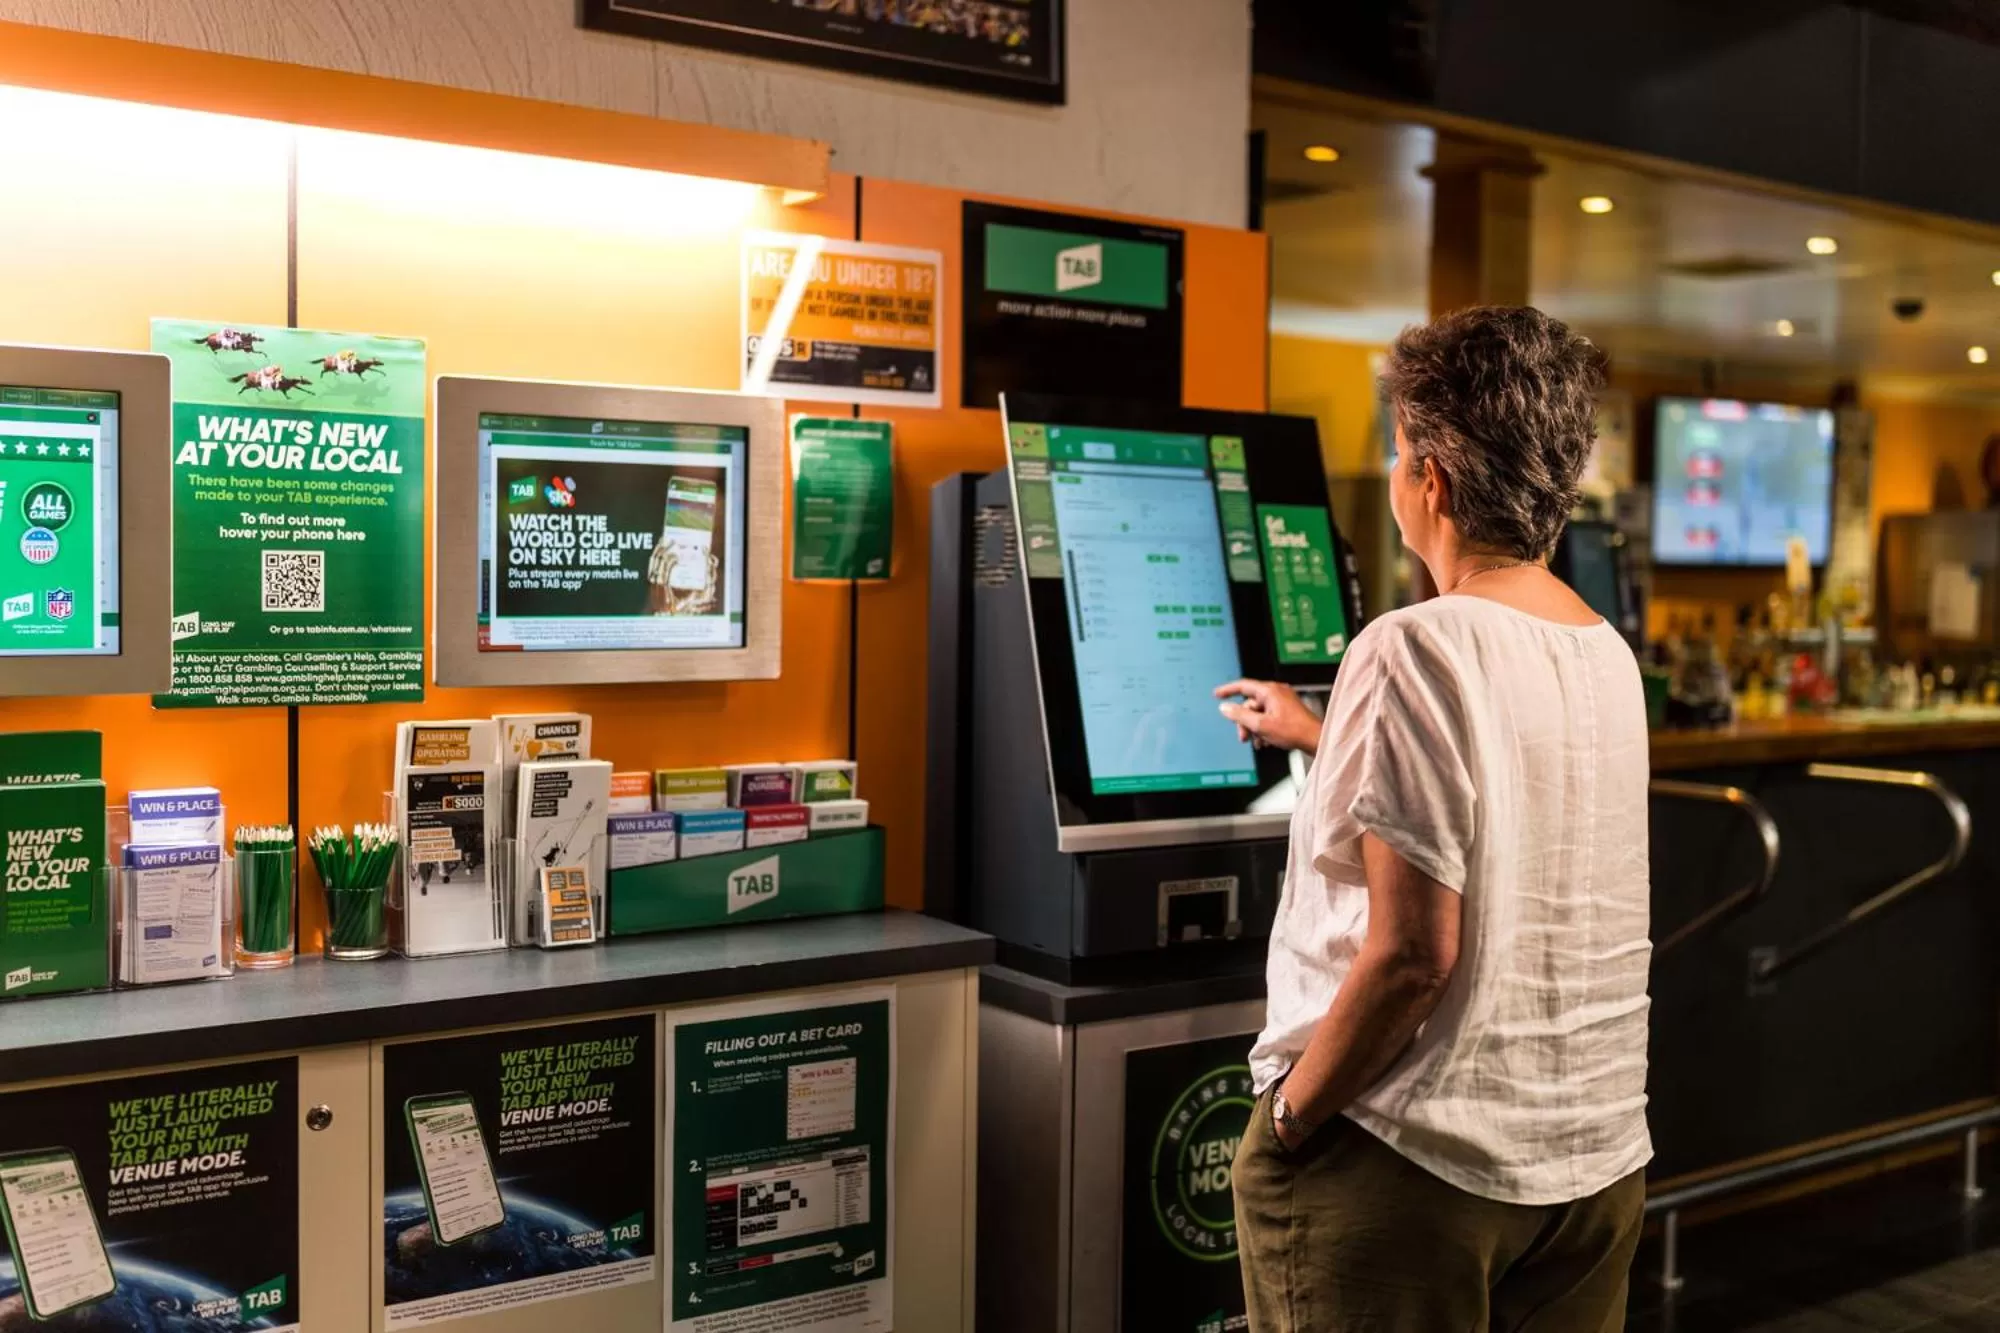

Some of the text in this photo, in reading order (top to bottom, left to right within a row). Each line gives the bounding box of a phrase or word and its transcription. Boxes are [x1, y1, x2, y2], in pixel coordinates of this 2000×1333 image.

[752, 253, 790, 278] ARE
[1063, 257, 1097, 277] TAB
[836, 260, 897, 289] UNDER
[904, 267, 933, 292] 18?
[997, 300, 1147, 328] more action more places
[198, 416, 389, 448] WHAT'S NEW
[175, 441, 403, 474] AT YOUR LOCAL
[188, 474, 394, 493] There have been some changes
[511, 485, 534, 497] TAB
[30, 494, 66, 511] ALL
[195, 490, 388, 507] made to your TAB experience.
[548, 491, 573, 503] SKY
[29, 509, 68, 521] GAMES
[240, 512, 346, 526] To find out more
[508, 513, 607, 532] WATCH THE
[219, 526, 366, 542] hover your phone here
[508, 531, 653, 550] WORLD CUP LIVE
[509, 549, 621, 566] ON SKY HERE
[508, 568, 639, 582] Plus stream every match live
[508, 580, 521, 589] on
[523, 579, 539, 589] the
[541, 579, 560, 589] TAB
[6, 601, 30, 613] TAB
[50, 602, 72, 615] NFL
[173, 622, 196, 633] TAB
[269, 624, 413, 636] Or go to tabinfo.com.au/whatsnew
[186, 653, 217, 663] About
[219, 655, 241, 665] your
[242, 653, 282, 663] choices.
[283, 652, 302, 662] Call
[304, 652, 352, 661] Gambler's
[354, 652, 376, 662] Help,
[378, 652, 423, 662] Gambling
[181, 661, 422, 674] or the ACT Gambling Counselling & Support Service
[189, 674, 212, 684] 1800
[214, 674, 233, 683] 858
[235, 674, 253, 683] 858
[254, 673, 395, 685] www.gamblinghelp.nsw.gov.au
[396, 672, 406, 681] or
[315, 682, 341, 692] Don't
[342, 682, 369, 691] chase
[370, 682, 391, 693] your
[392, 681, 422, 691] losses.
[215, 692, 369, 705] Walk away. Gamble Responsibly.
[419, 732, 466, 742] GAMBLING
[537, 725, 578, 737] CHANCES
[416, 748, 468, 758] OPERATORS
[566, 740, 577, 749] OF
[139, 799, 214, 814] WIN & PLACE
[615, 818, 672, 831] WIN & PLACE
[6, 827, 84, 846] WHAT'S
[6, 844, 54, 861] NEW
[140, 850, 217, 866] WIN & PLACE
[5, 857, 90, 877] AT YOUR
[6, 874, 71, 892] LOCAL
[733, 874, 774, 896] TAB
[9, 972, 29, 984] TAB
[704, 1022, 863, 1055] FILLING OUT A BET CARD
[501, 1035, 640, 1067] WE'VE LITERALLY
[500, 1052, 635, 1082] JUST LAUNCHED
[713, 1054, 768, 1069] When meeting
[500, 1070, 591, 1096] YOUR NEW
[689, 1080, 703, 1094] 1.
[109, 1080, 279, 1119] WE'VE LITERALLY
[500, 1082, 615, 1112] TAB APP WITH
[108, 1098, 273, 1135] JUST LAUNCHED
[501, 1098, 613, 1127] VENUE MODE.
[1168, 1078, 1229, 1141] BRING
[110, 1121, 220, 1152] YOUR NEW
[110, 1133, 249, 1168] TAB APP WITH
[1189, 1136, 1242, 1168] VEN
[109, 1149, 247, 1185] VENUE MODE.
[688, 1159, 702, 1173] 2.
[108, 1171, 244, 1199] Get the home ground advantage
[1190, 1165, 1233, 1197] MO
[108, 1174, 270, 1207] here with your new TAB app for exclusive
[610, 1224, 641, 1242] TAB
[1166, 1203, 1217, 1248] LOCAL
[688, 1261, 701, 1275] 3.
[246, 1288, 282, 1310] TAB
[688, 1291, 702, 1303] 4.
